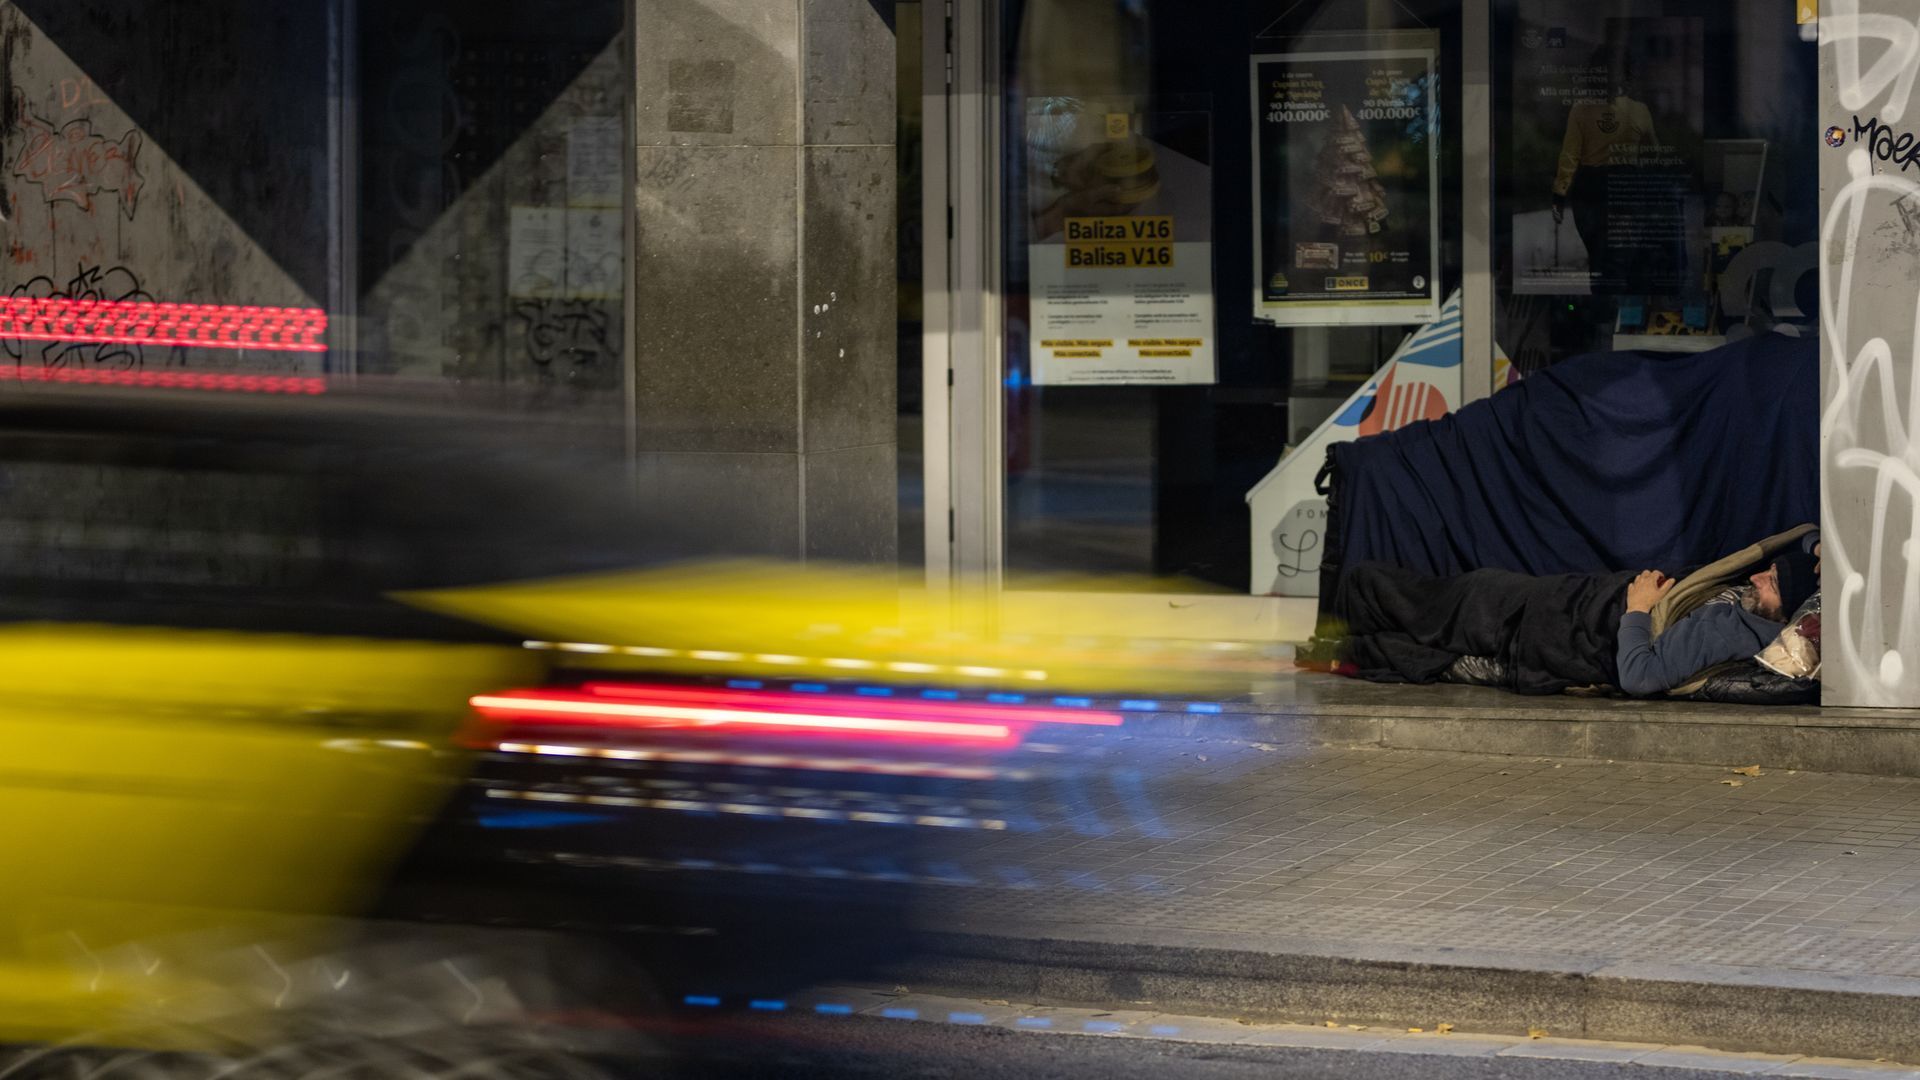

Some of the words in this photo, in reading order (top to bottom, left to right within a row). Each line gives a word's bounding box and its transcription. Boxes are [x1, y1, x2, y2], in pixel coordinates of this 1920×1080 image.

[1572, 87, 1608, 96] Correos
[1270, 102, 1282, 110] 90
[1607, 156, 1629, 165] AXA
[1068, 221, 1126, 240] Baliza
[1131, 220, 1170, 239] V16
[1069, 247, 1126, 266] Balisa
[1132, 246, 1171, 265] V16
[1338, 279, 1366, 287] ONCE
